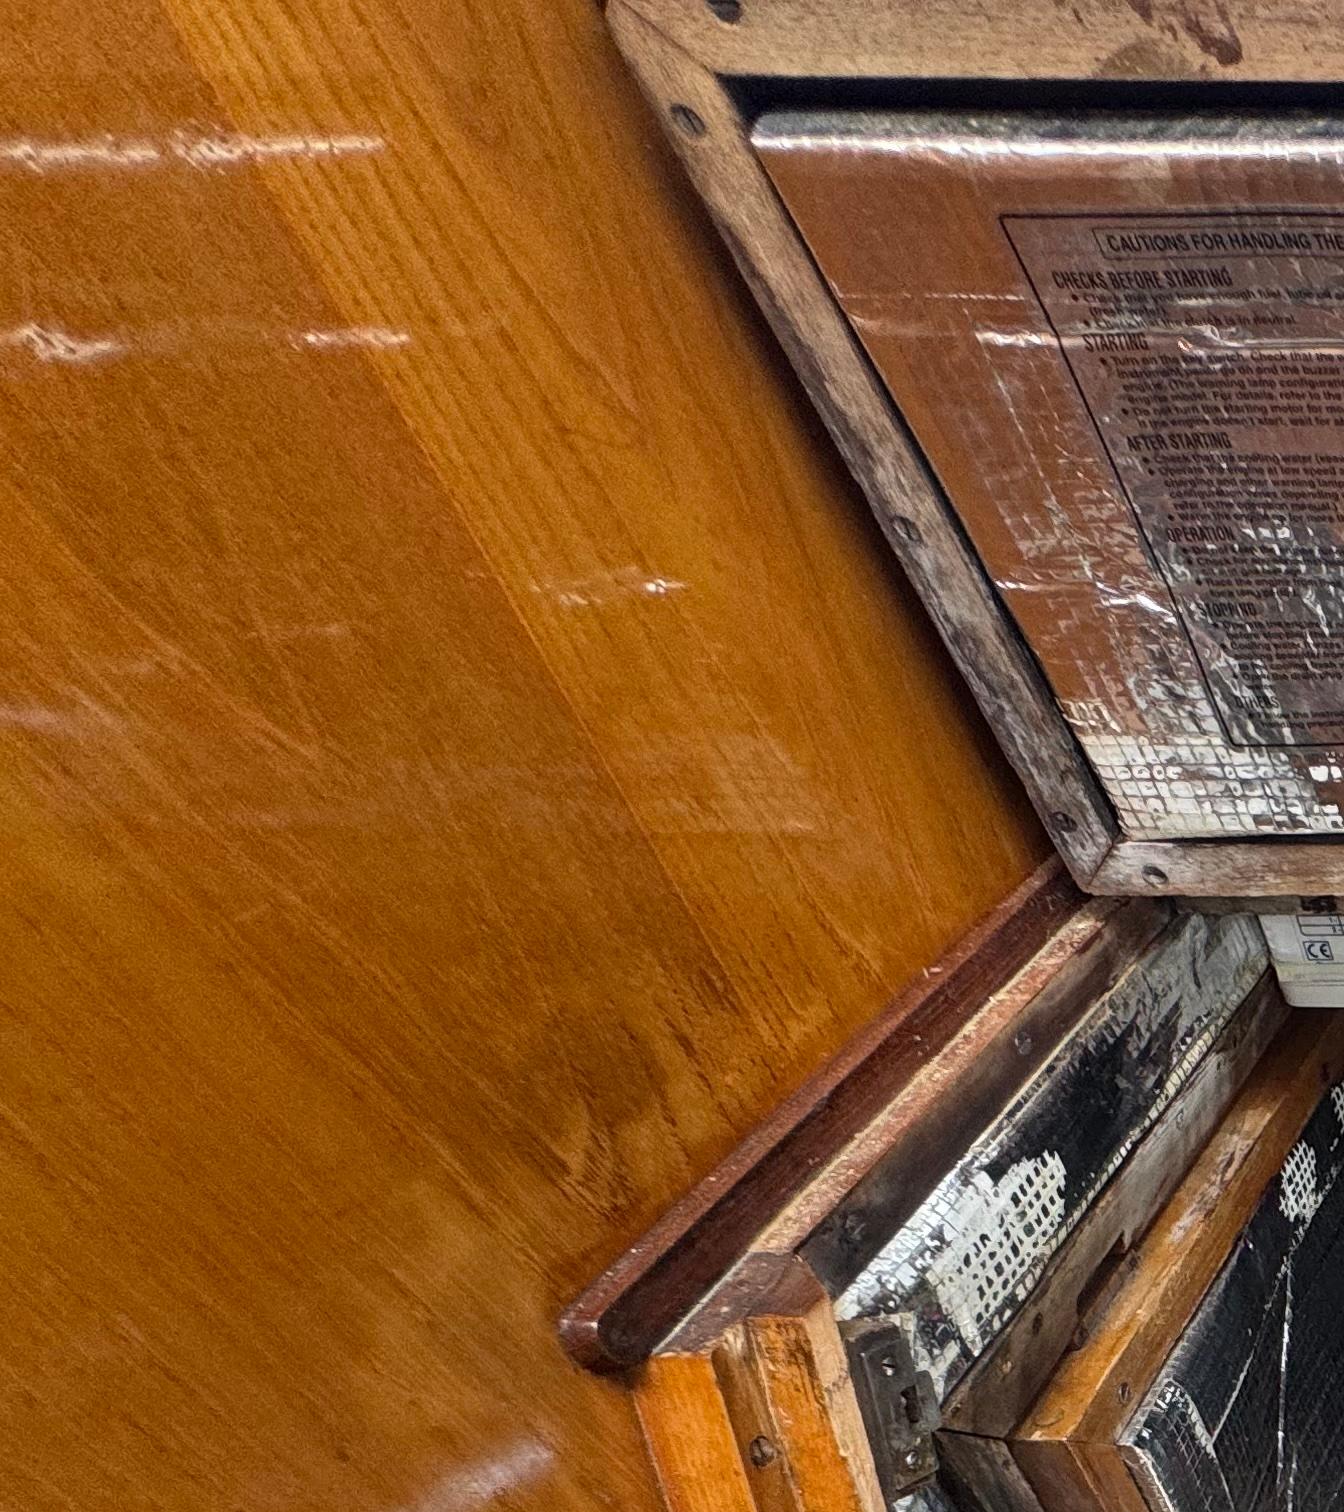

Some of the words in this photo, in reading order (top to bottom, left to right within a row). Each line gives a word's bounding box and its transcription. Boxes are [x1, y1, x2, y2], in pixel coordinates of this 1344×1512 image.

[1107, 235, 1189, 251] CAUTIONS
[1191, 234, 1227, 250] FOR
[1228, 233, 1311, 249] HANDLING
[1052, 271, 1108, 290] CHECKS
[1110, 271, 1165, 289] BEFORE
[1166, 267, 1233, 287] STARTING
[1084, 334, 1149, 352] STARTING
[1127, 433, 1168, 451] AFTER
[1170, 433, 1231, 450] STARTING
